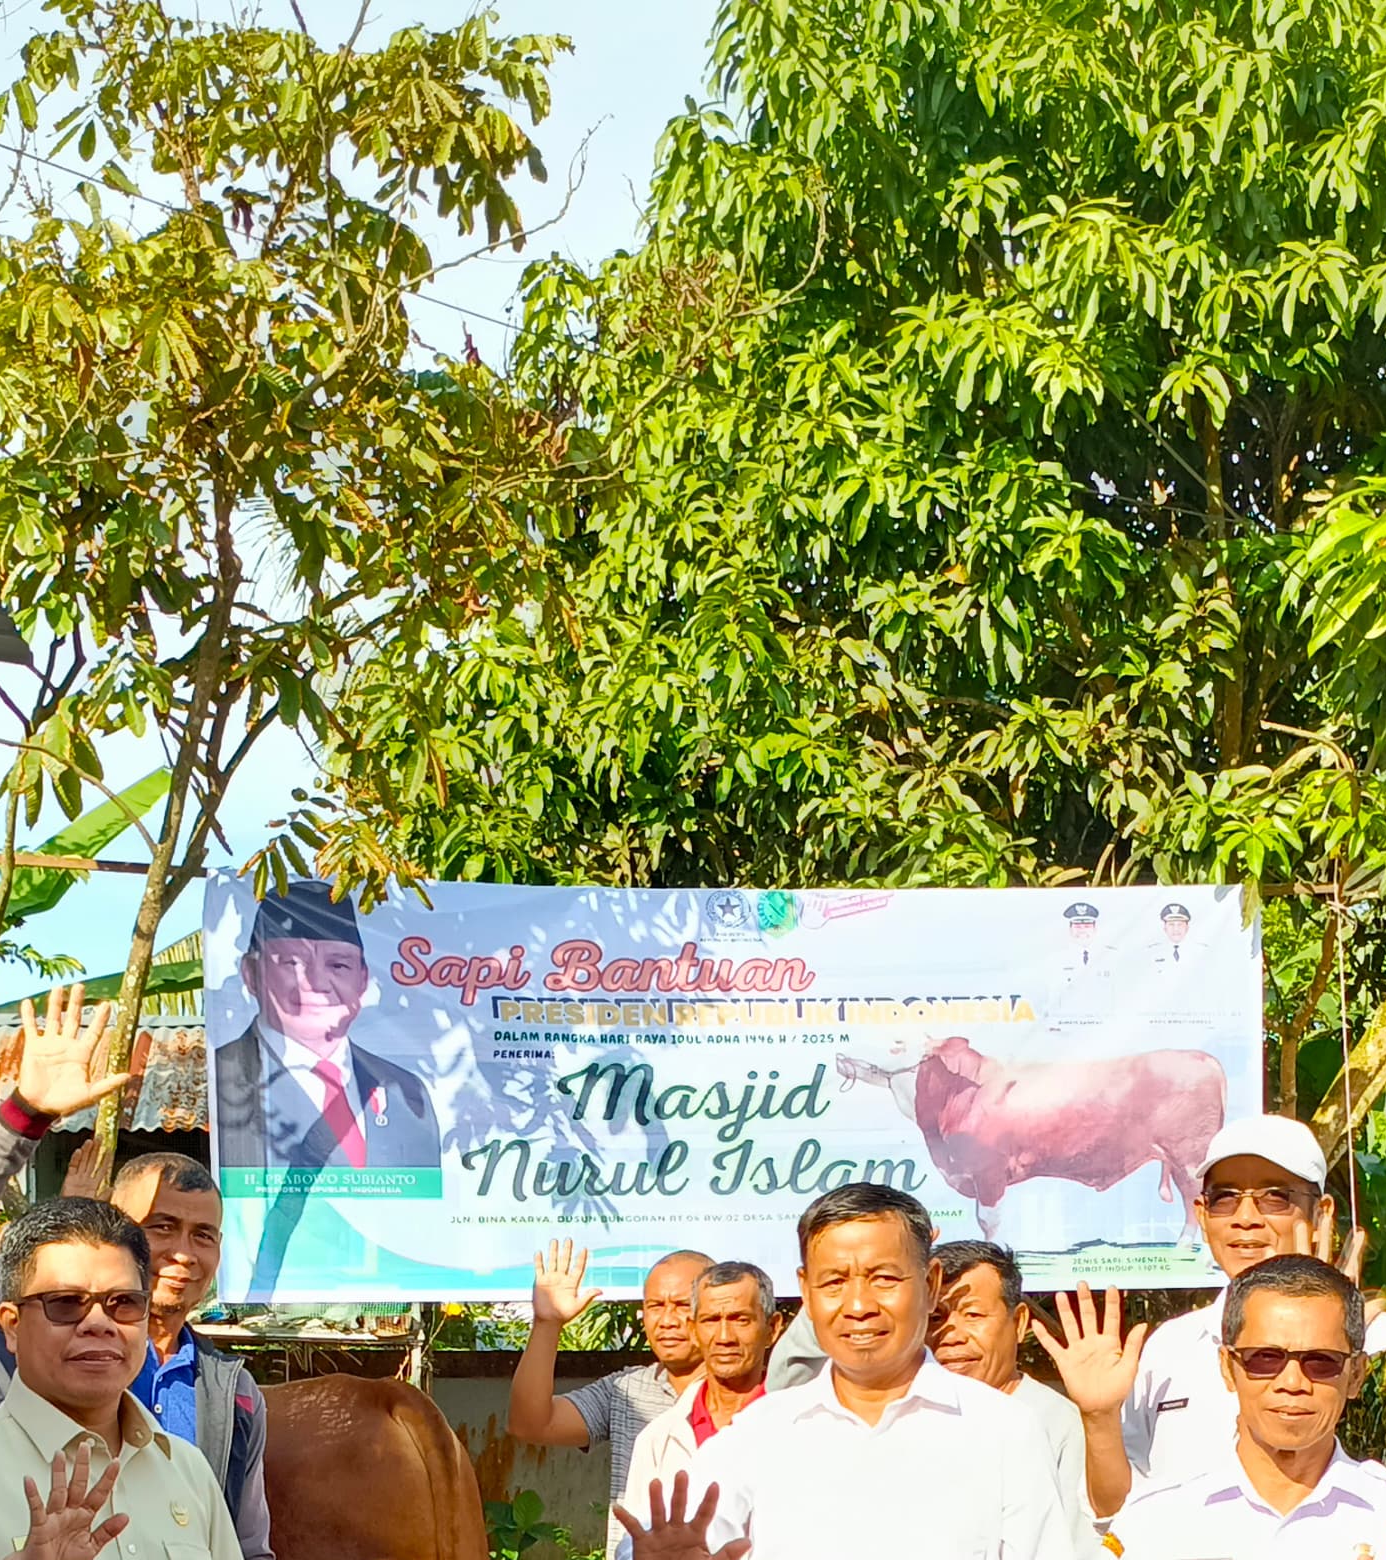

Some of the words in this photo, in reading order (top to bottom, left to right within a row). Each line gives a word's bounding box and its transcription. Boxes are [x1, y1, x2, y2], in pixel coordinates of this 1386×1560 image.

[390, 936, 531, 1006] Sapi
[544, 940, 815, 993] Bantuan
[493, 996, 670, 1027] PRESIDEN
[667, 998, 836, 1026] REPUBLIK
[838, 995, 1036, 1025] INDONESIA
[494, 1030, 540, 1042] DALAM
[544, 1031, 596, 1043] RANGKA
[600, 1033, 630, 1045] HARI
[635, 1033, 667, 1045] RAYA
[671, 1034, 702, 1045] IDUL
[707, 1034, 741, 1045] ADHA
[745, 1034, 774, 1045] 1446
[779, 1034, 787, 1044] H
[802, 1034, 835, 1044] 2025
[840, 1034, 850, 1043] M
[493, 1049, 555, 1059] PENERIMA:
[556, 1062, 831, 1142] Masjid
[244, 1173, 259, 1185] H.
[265, 1173, 338, 1185] PRABOWO
[343, 1173, 417, 1185] SUBIANTO
[461, 1139, 691, 1201] Nurul
[709, 1138, 928, 1196] Islam
